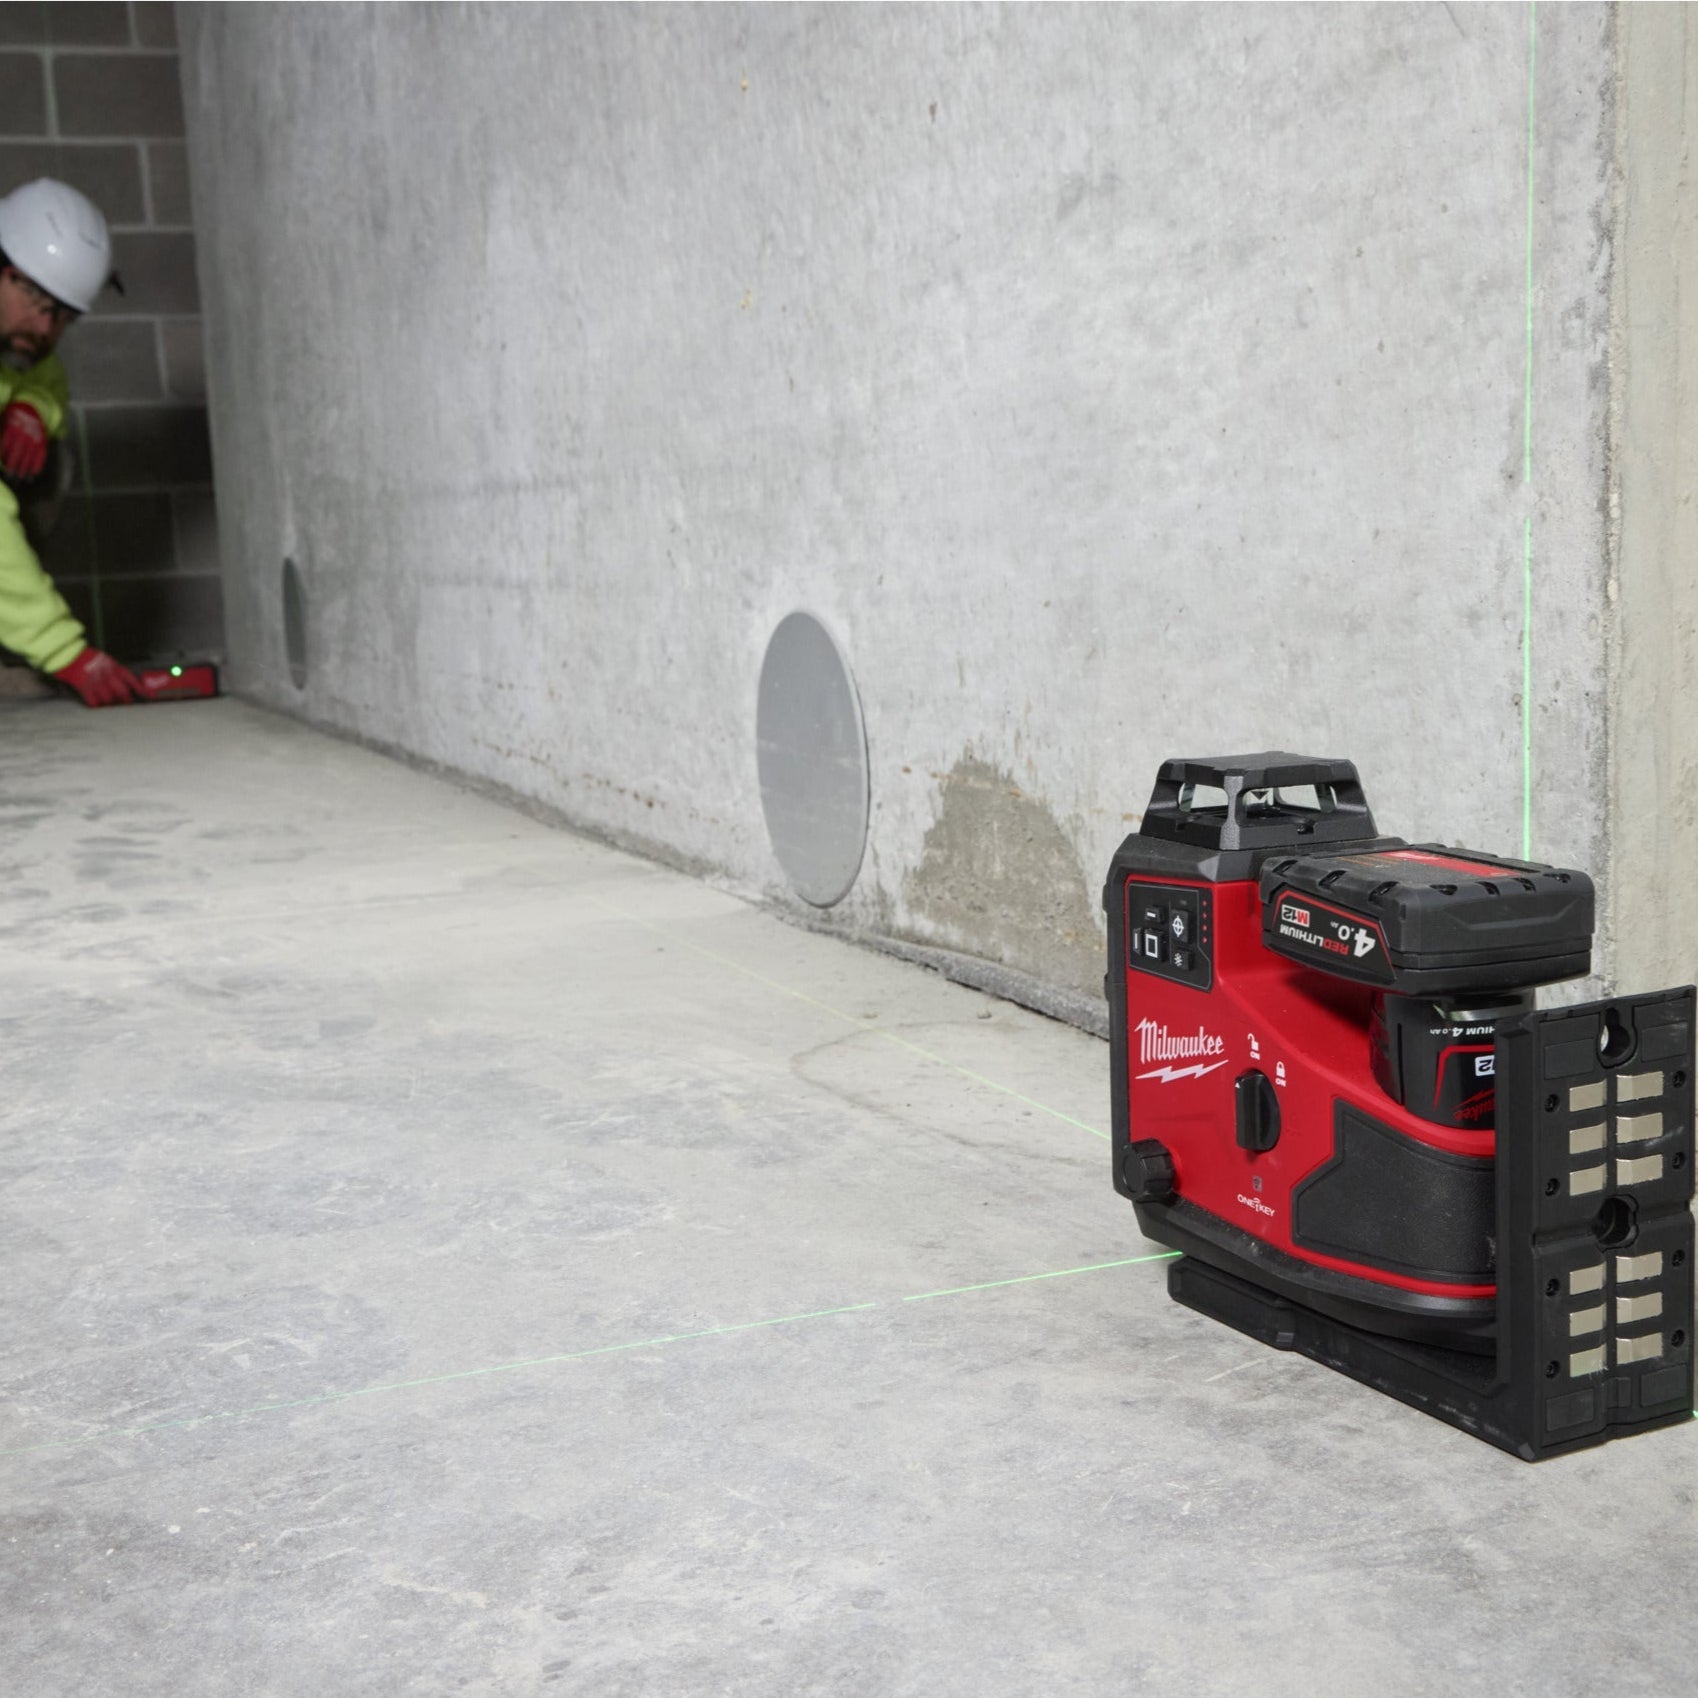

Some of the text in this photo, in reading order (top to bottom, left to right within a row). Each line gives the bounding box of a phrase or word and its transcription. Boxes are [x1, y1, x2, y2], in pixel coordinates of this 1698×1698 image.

[1282, 906, 1310, 926] M12
[1280, 923, 1351, 956] REDLITHIUM
[1134, 1017, 1225, 1065] Milwaukee
